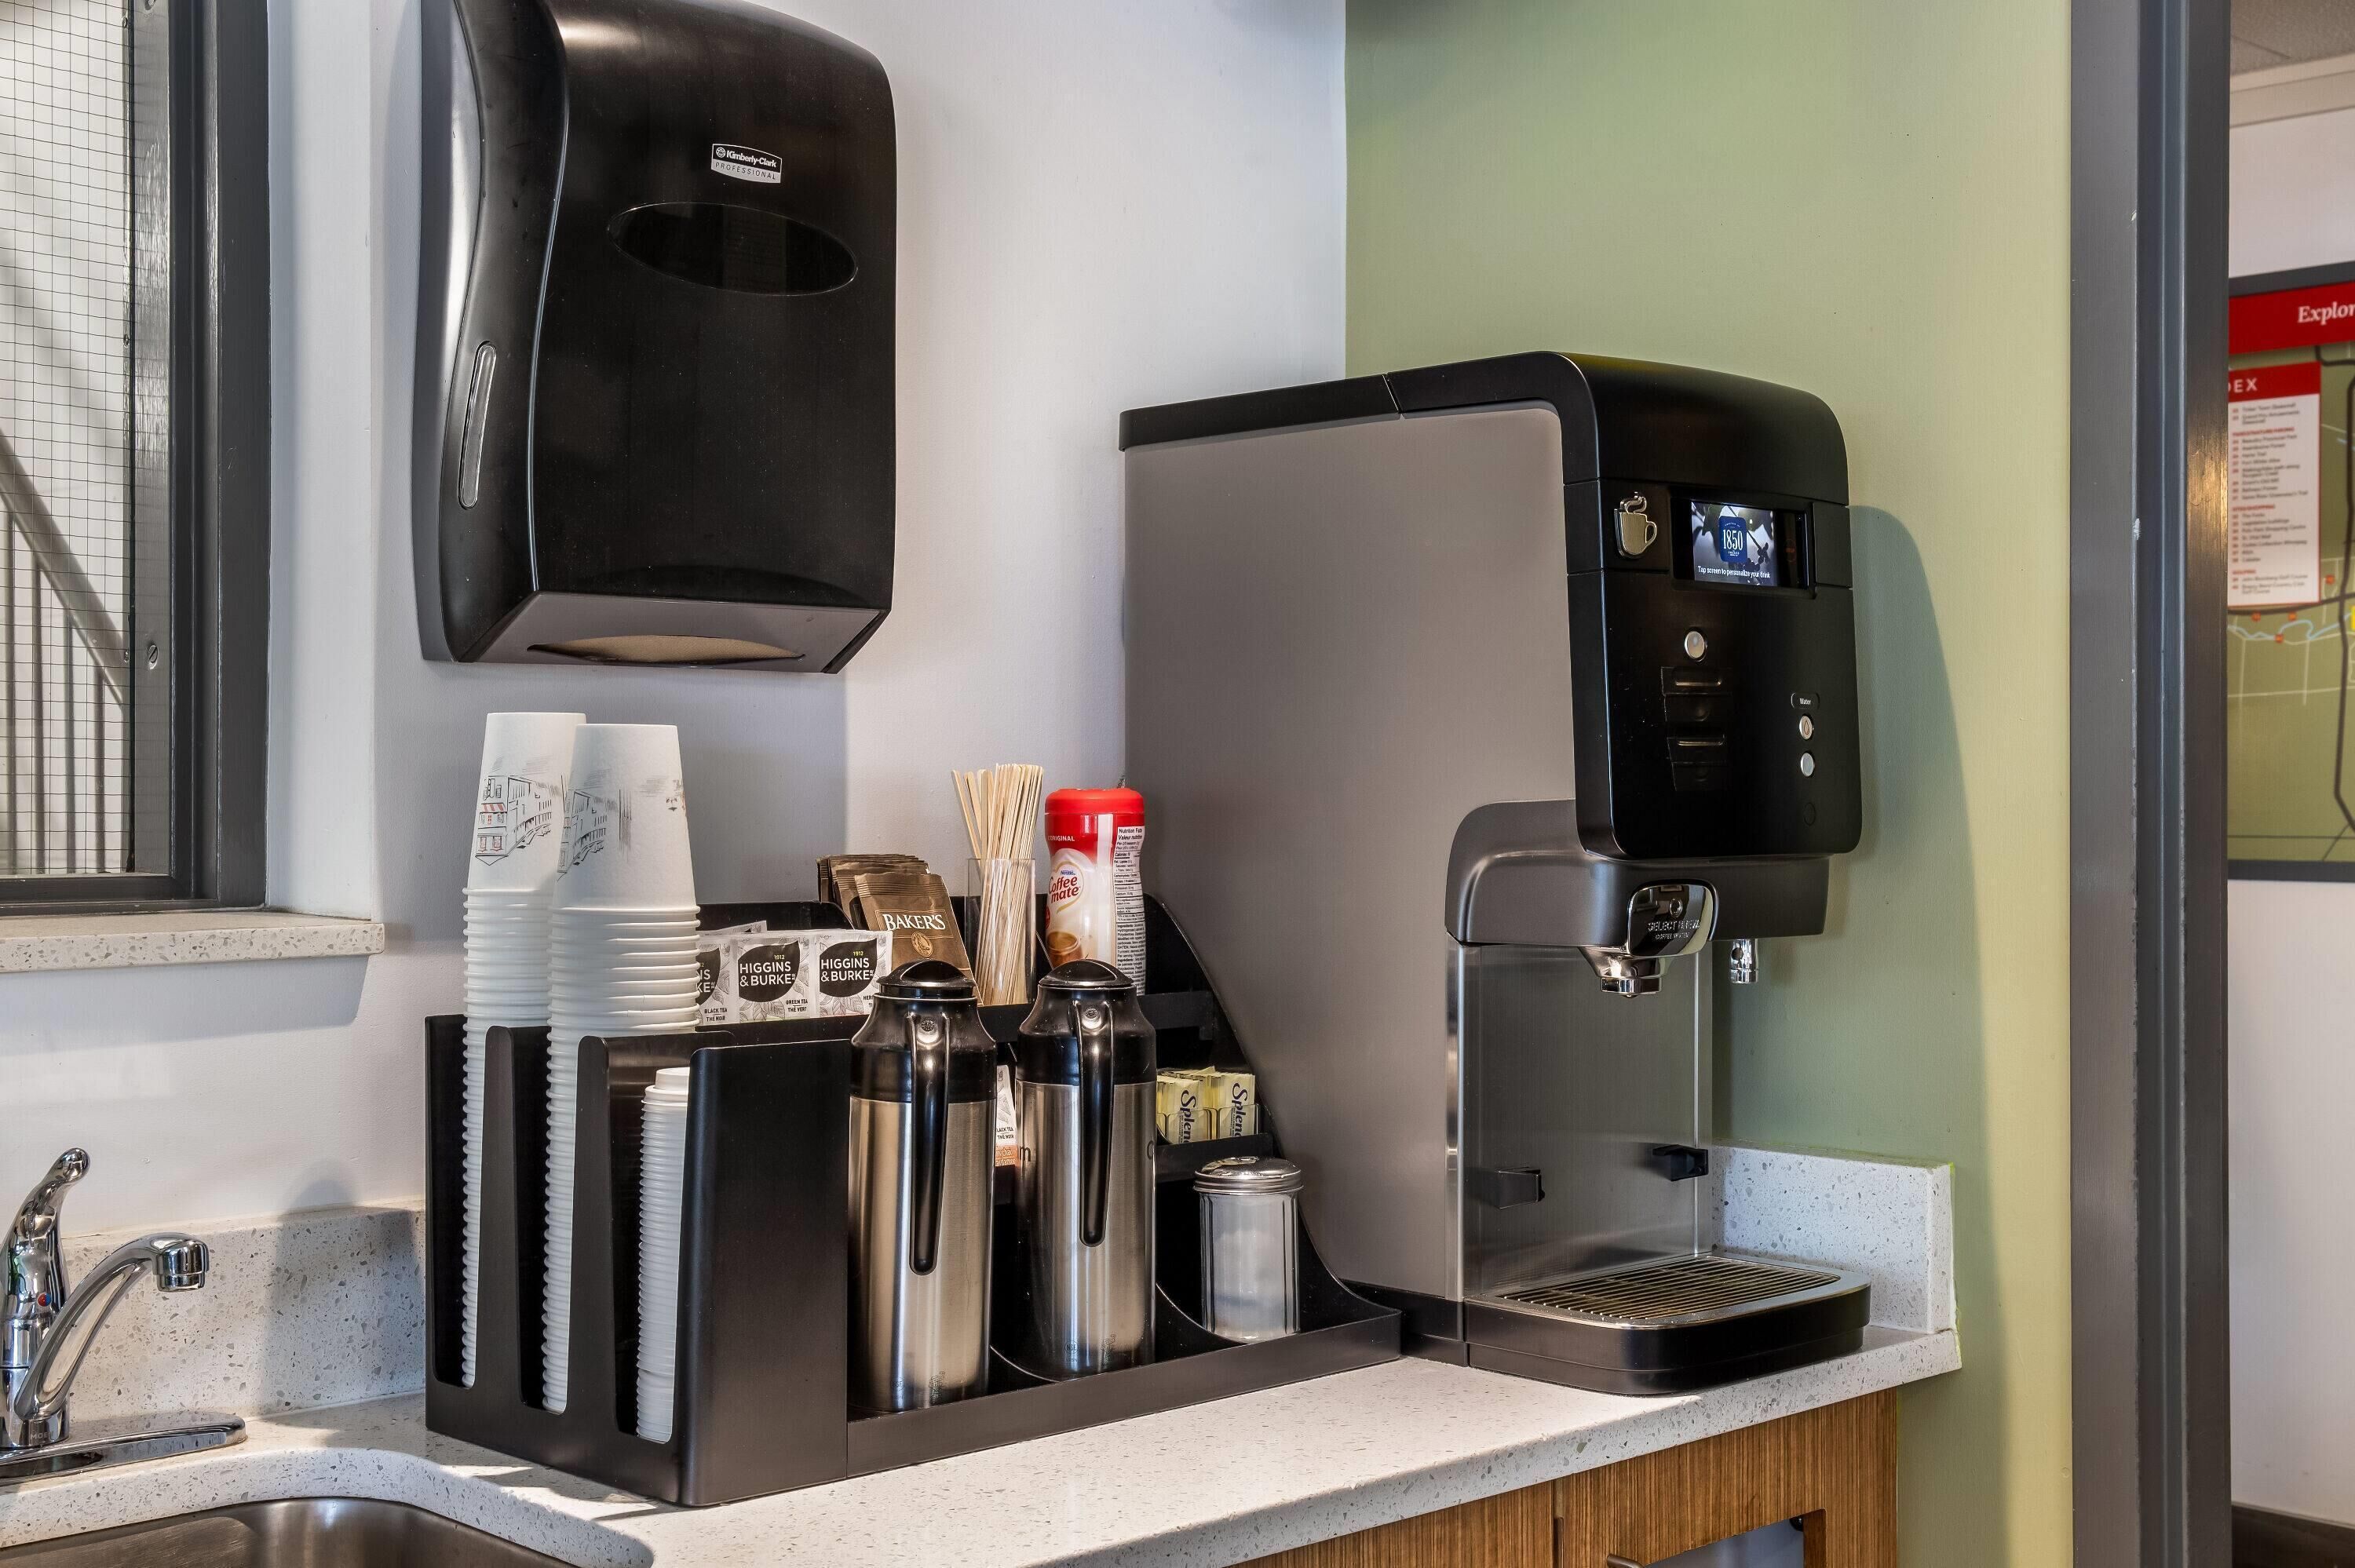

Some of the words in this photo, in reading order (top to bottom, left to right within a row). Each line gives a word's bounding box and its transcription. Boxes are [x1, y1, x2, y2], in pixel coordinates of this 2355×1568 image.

[726, 150, 777, 168] Kimberly-Clark
[715, 162, 776, 180] PROFESSIONAL
[1722, 529, 1743, 551] 1850
[1698, 565, 1707, 574] Tap
[1049, 876, 1078, 895] Coffee
[1051, 887, 1079, 903] mate
[882, 914, 946, 932] BAKER'S
[739, 961, 791, 974] HIGGINS
[820, 957, 870, 970] HIGGINS
[739, 975, 749, 987] &
[750, 973, 792, 986] BURKE
[820, 971, 830, 983] &
[831, 969, 871, 982] BURKE
[1180, 1089, 1196, 1143] Splen
